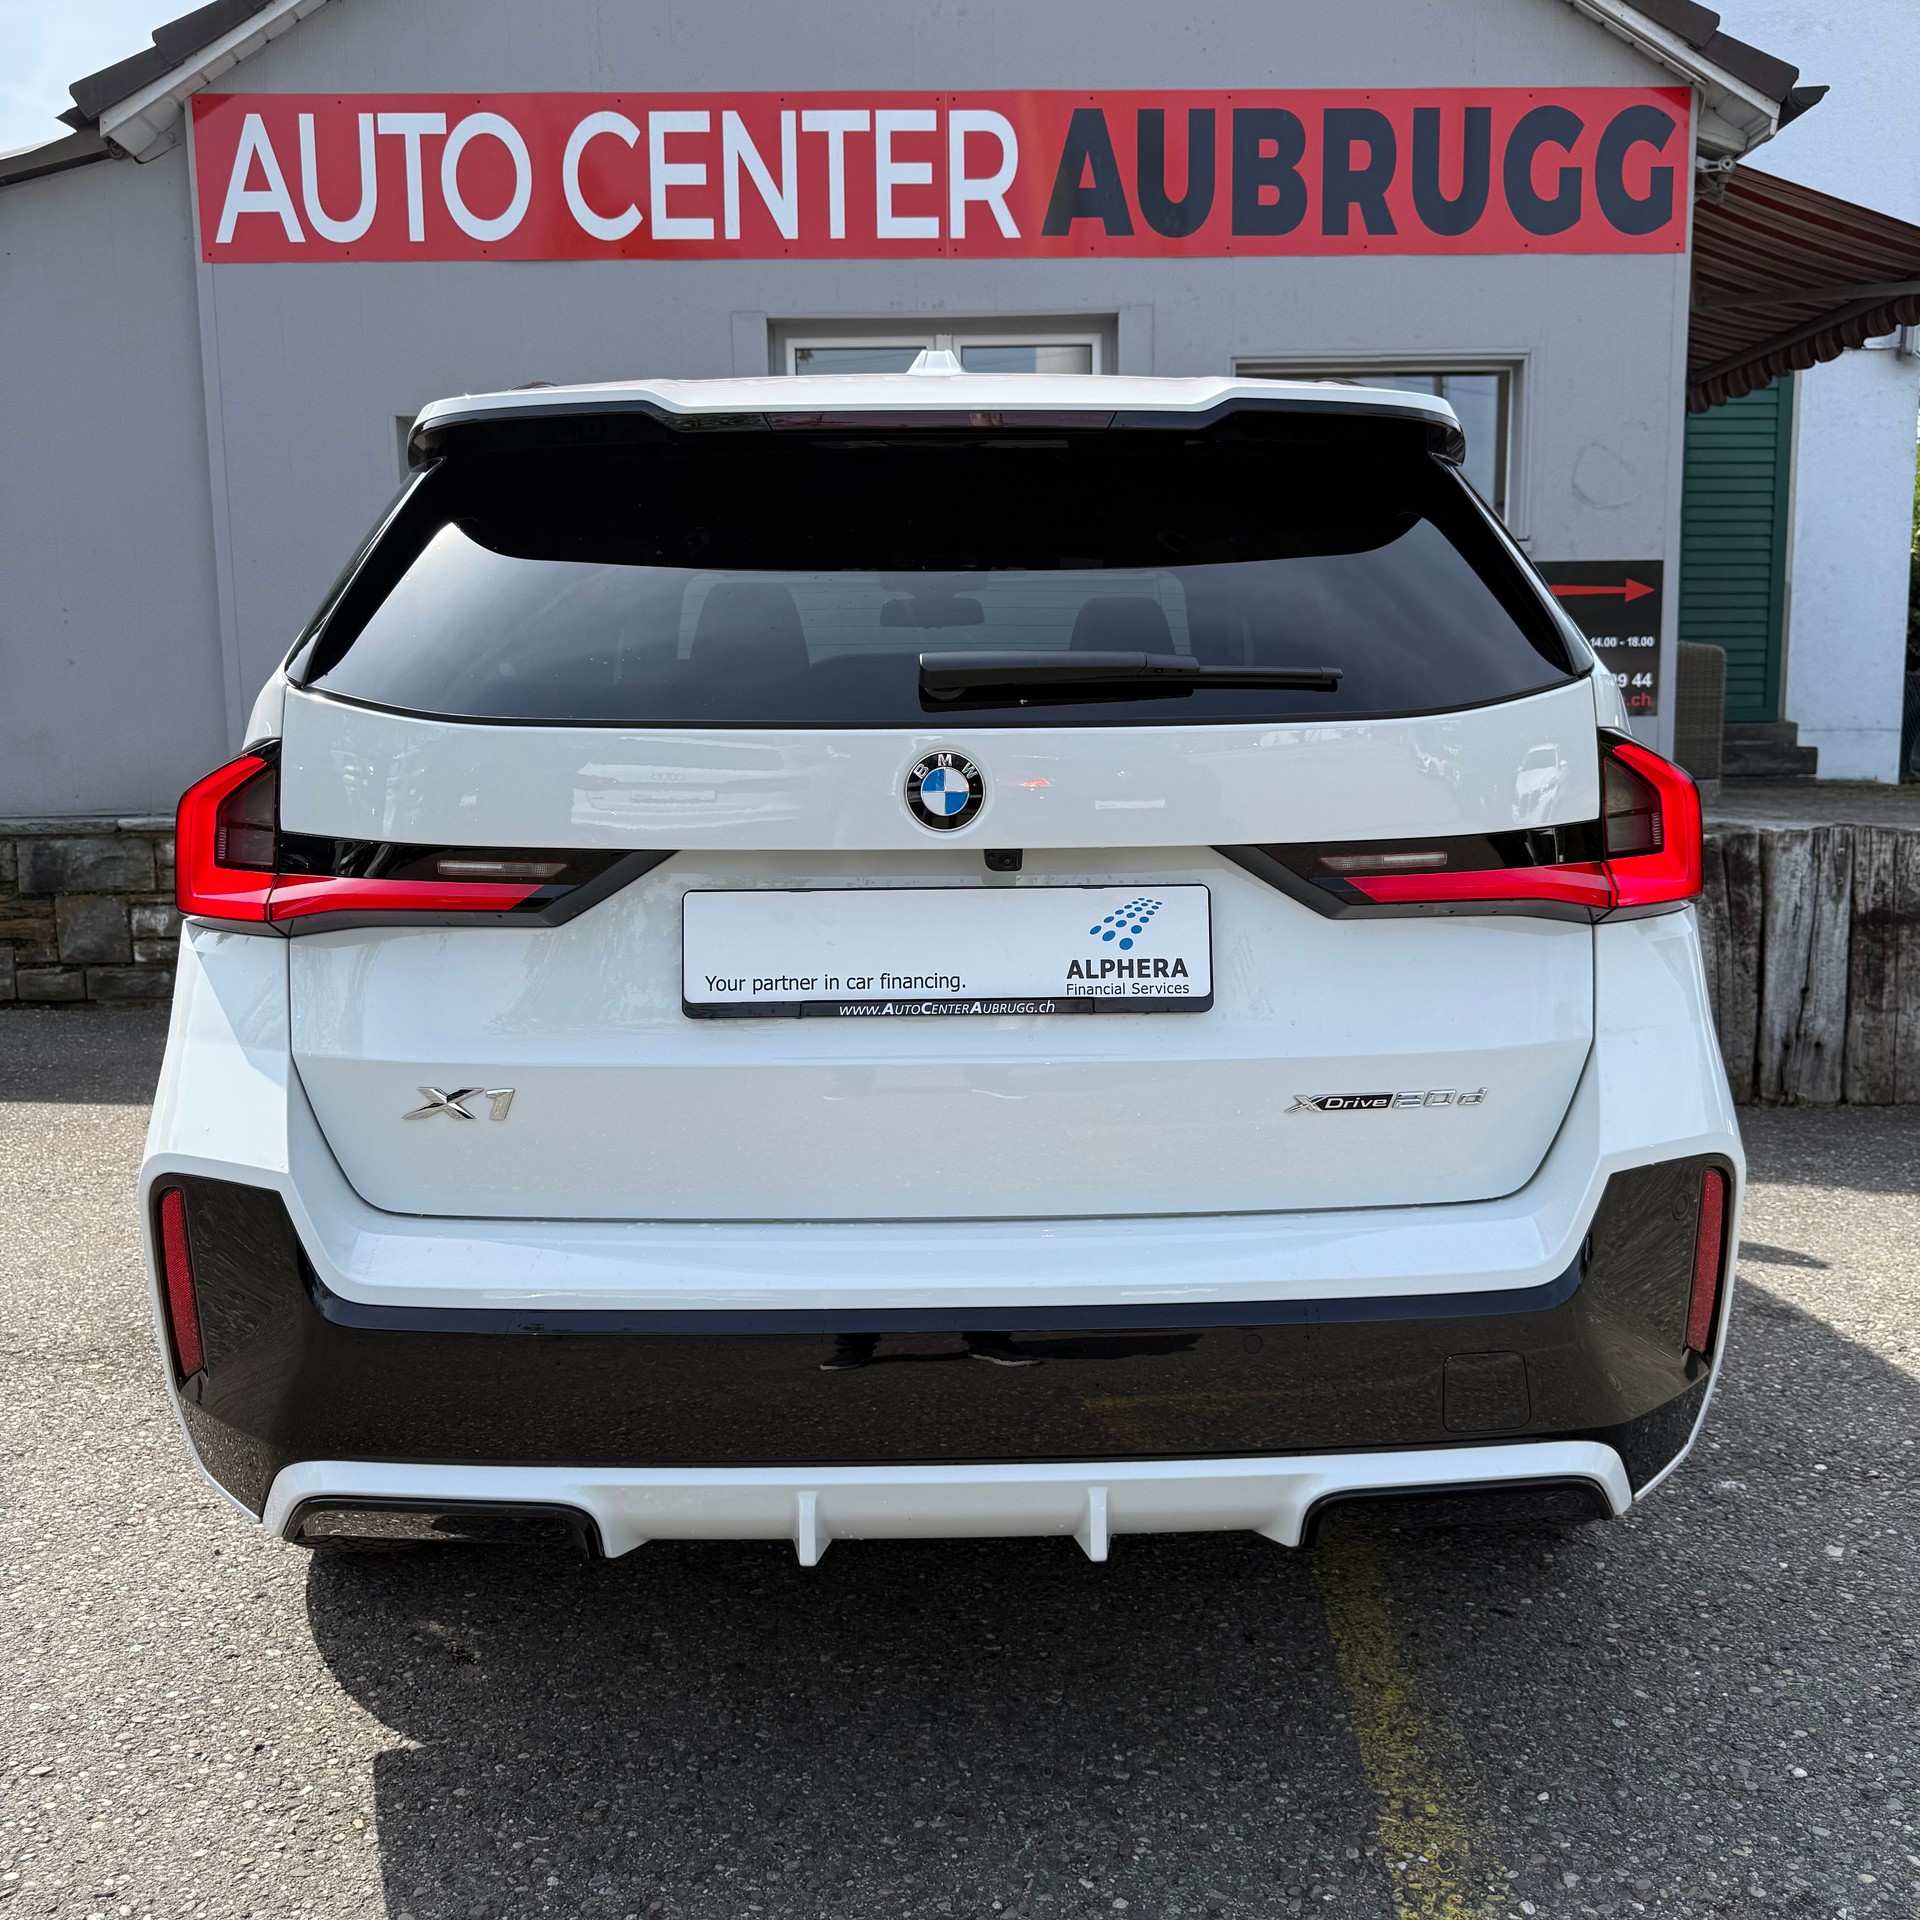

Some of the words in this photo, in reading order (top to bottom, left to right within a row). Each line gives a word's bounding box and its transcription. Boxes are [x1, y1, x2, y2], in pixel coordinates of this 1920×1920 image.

[215, 111, 533, 244] AUTO
[562, 109, 1021, 241] CENTER
[1041, 104, 1677, 237] AUBRUGG
[1589, 636, 1617, 648] 14.00
[1626, 636, 1655, 648] 18.00
[1631, 672, 1653, 688] 44
[1623, 692, 1652, 707] .ch
[913, 753, 978, 779] BMW
[1066, 957, 1189, 979] ALPHERA
[705, 975, 746, 992] Your
[752, 975, 818, 995] partner
[824, 974, 840, 990] in
[846, 976, 874, 990] car
[880, 972, 967, 992] financing.
[1066, 982, 1126, 996] Financial
[1131, 981, 1190, 995] Services
[401, 1086, 516, 1121] X1
